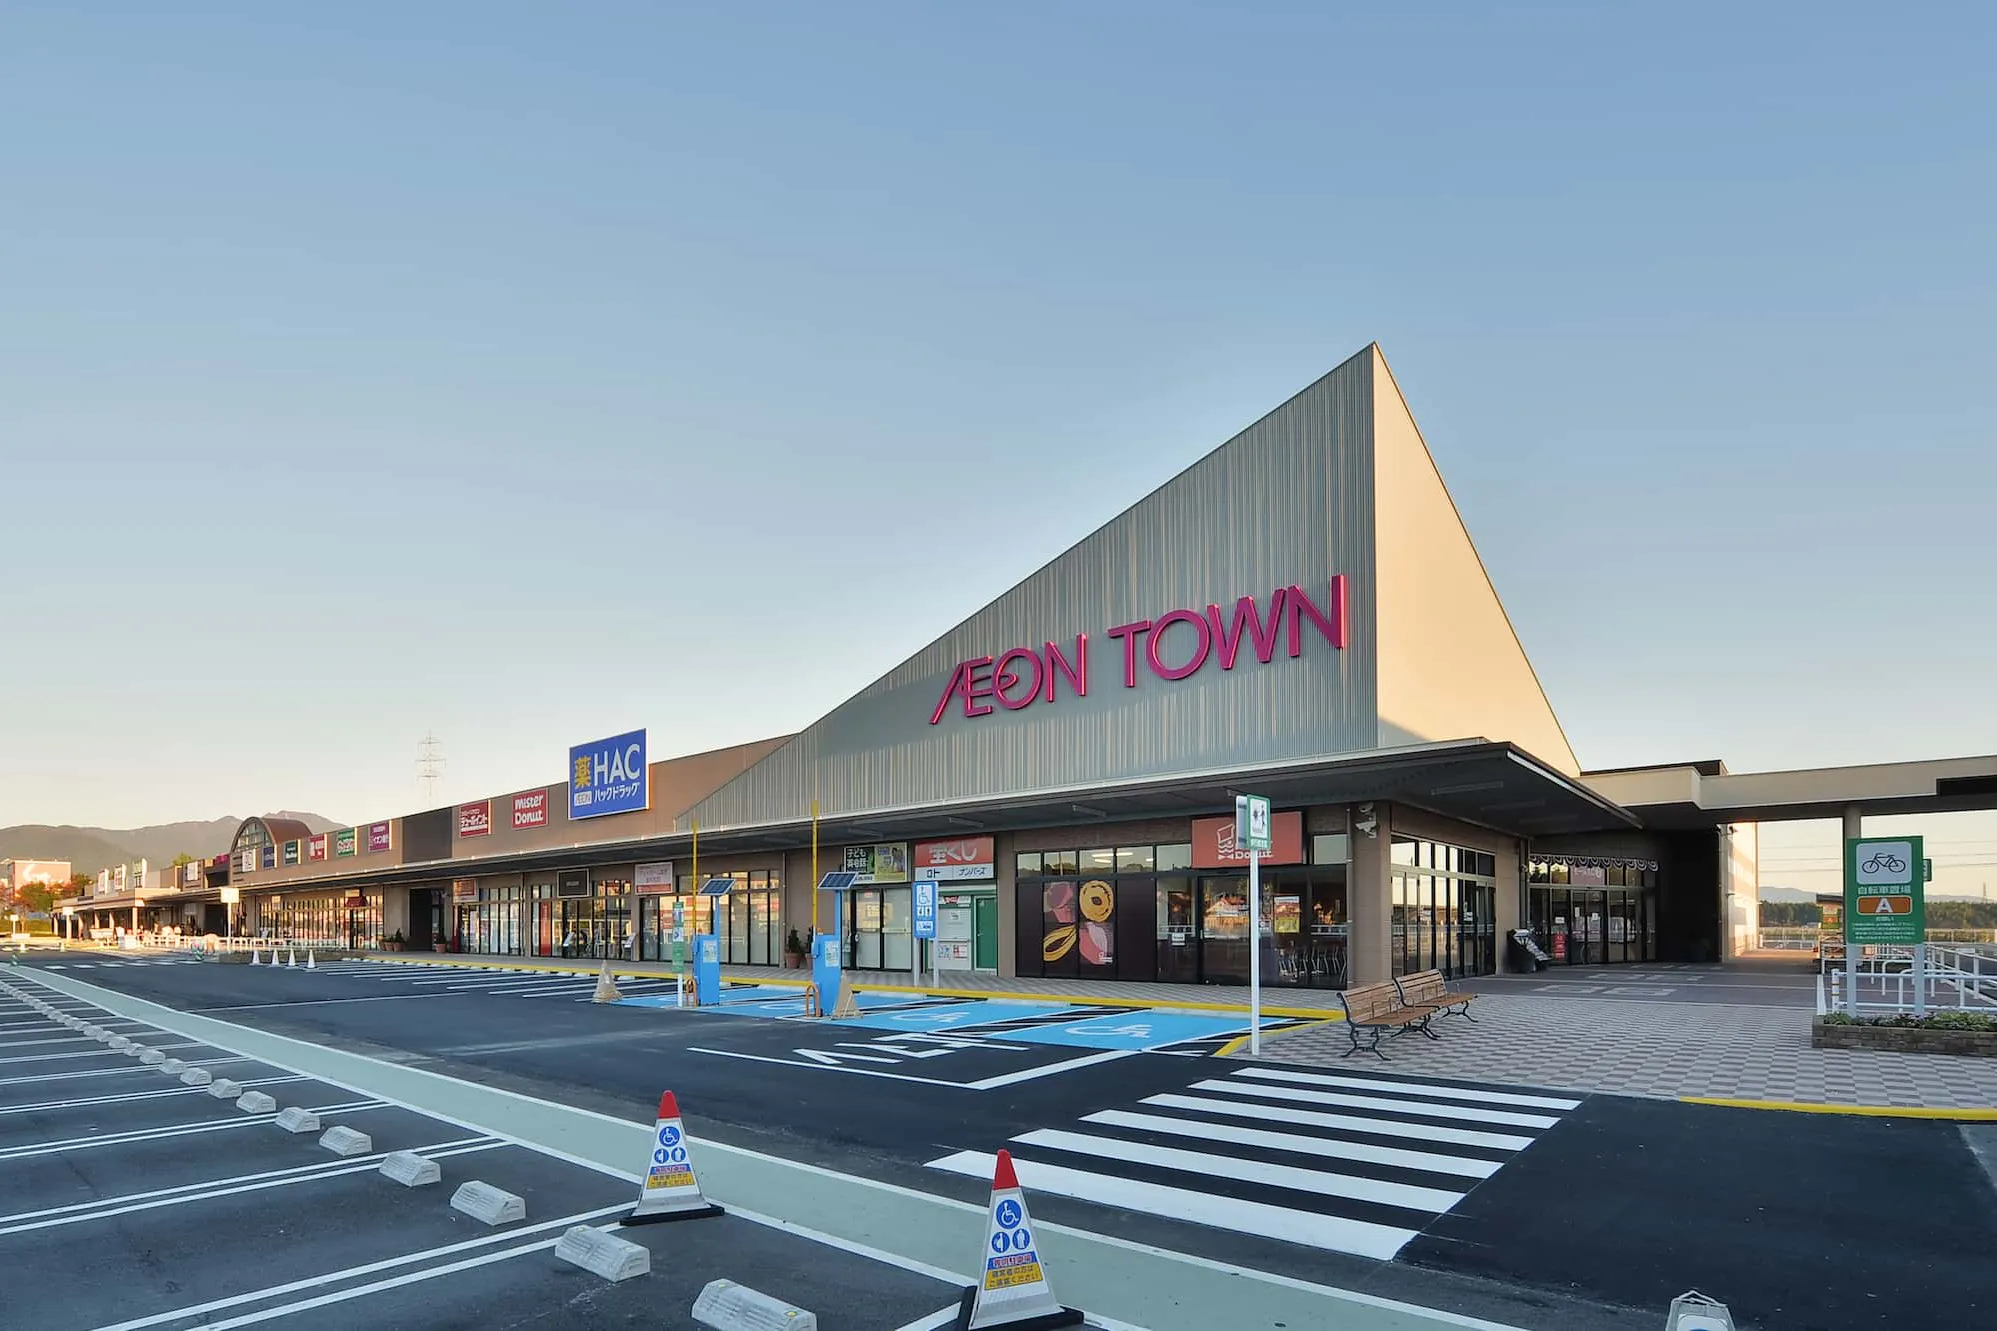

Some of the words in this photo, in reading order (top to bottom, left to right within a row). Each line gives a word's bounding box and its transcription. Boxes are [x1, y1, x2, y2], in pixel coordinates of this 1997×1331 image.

[1107, 574, 1346, 688] TOWN
[575, 755, 591, 789] 薬
[594, 743, 640, 787] HAC
[594, 782, 640, 802] ハックドラッグ
[847, 847, 867, 858] 子ども
[847, 858, 867, 868] 英会話
[927, 868, 940, 878] ロト
[1876, 898, 1893, 912] A
